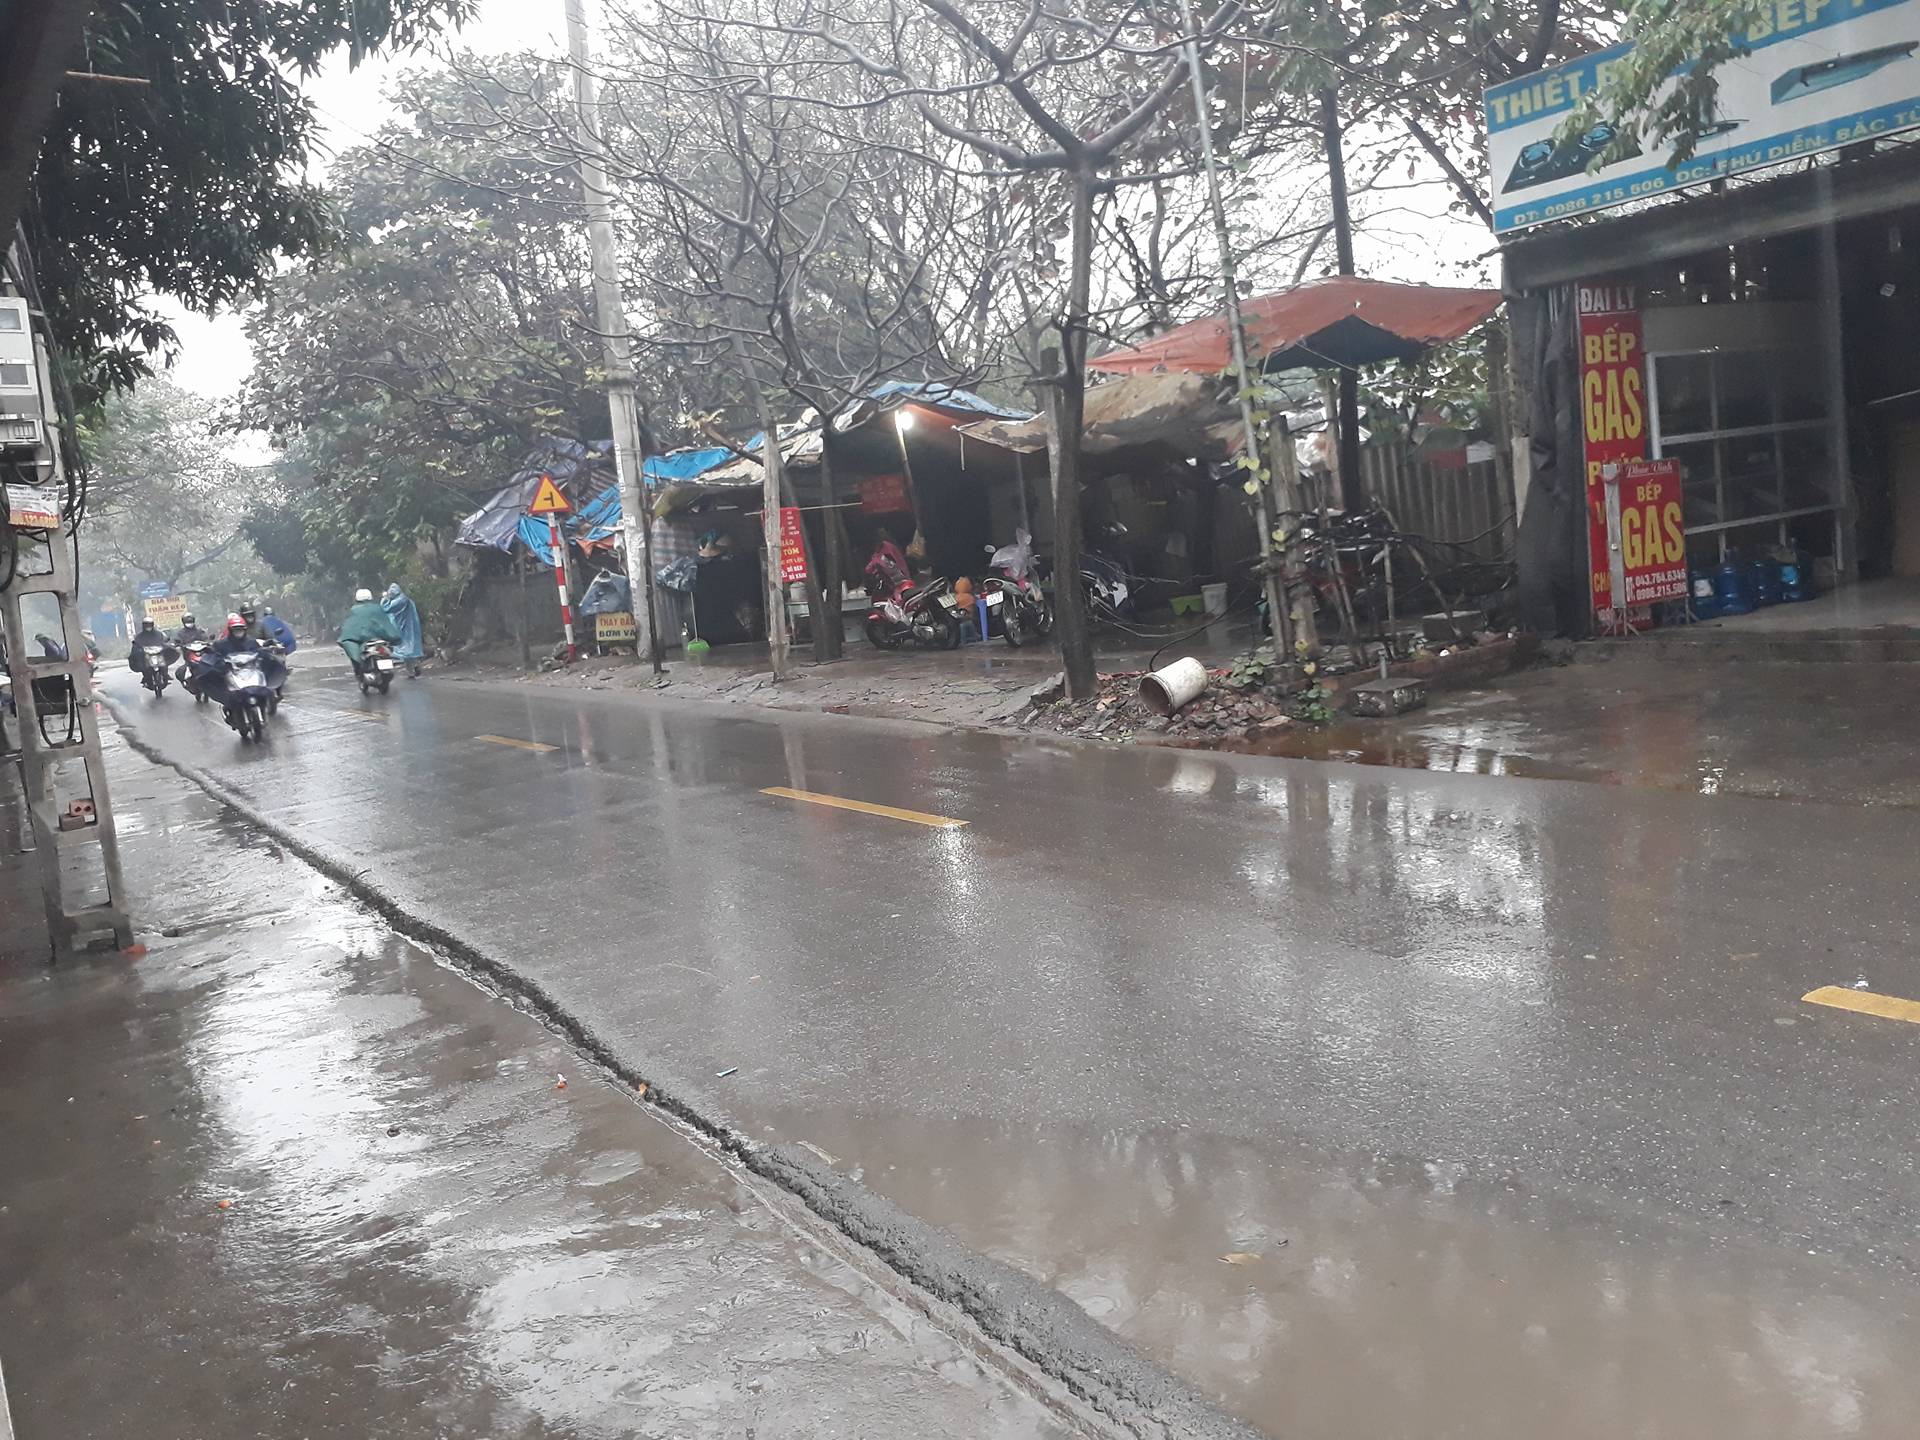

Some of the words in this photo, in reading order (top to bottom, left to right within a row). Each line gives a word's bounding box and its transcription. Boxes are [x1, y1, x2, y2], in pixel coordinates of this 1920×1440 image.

[1591, 187, 1624, 204] 215
[1584, 322, 1637, 364] BẾP
[1584, 367, 1643, 443] GAS
[1636, 479, 1662, 502] BẾP
[1622, 502, 1685, 569] GAS
